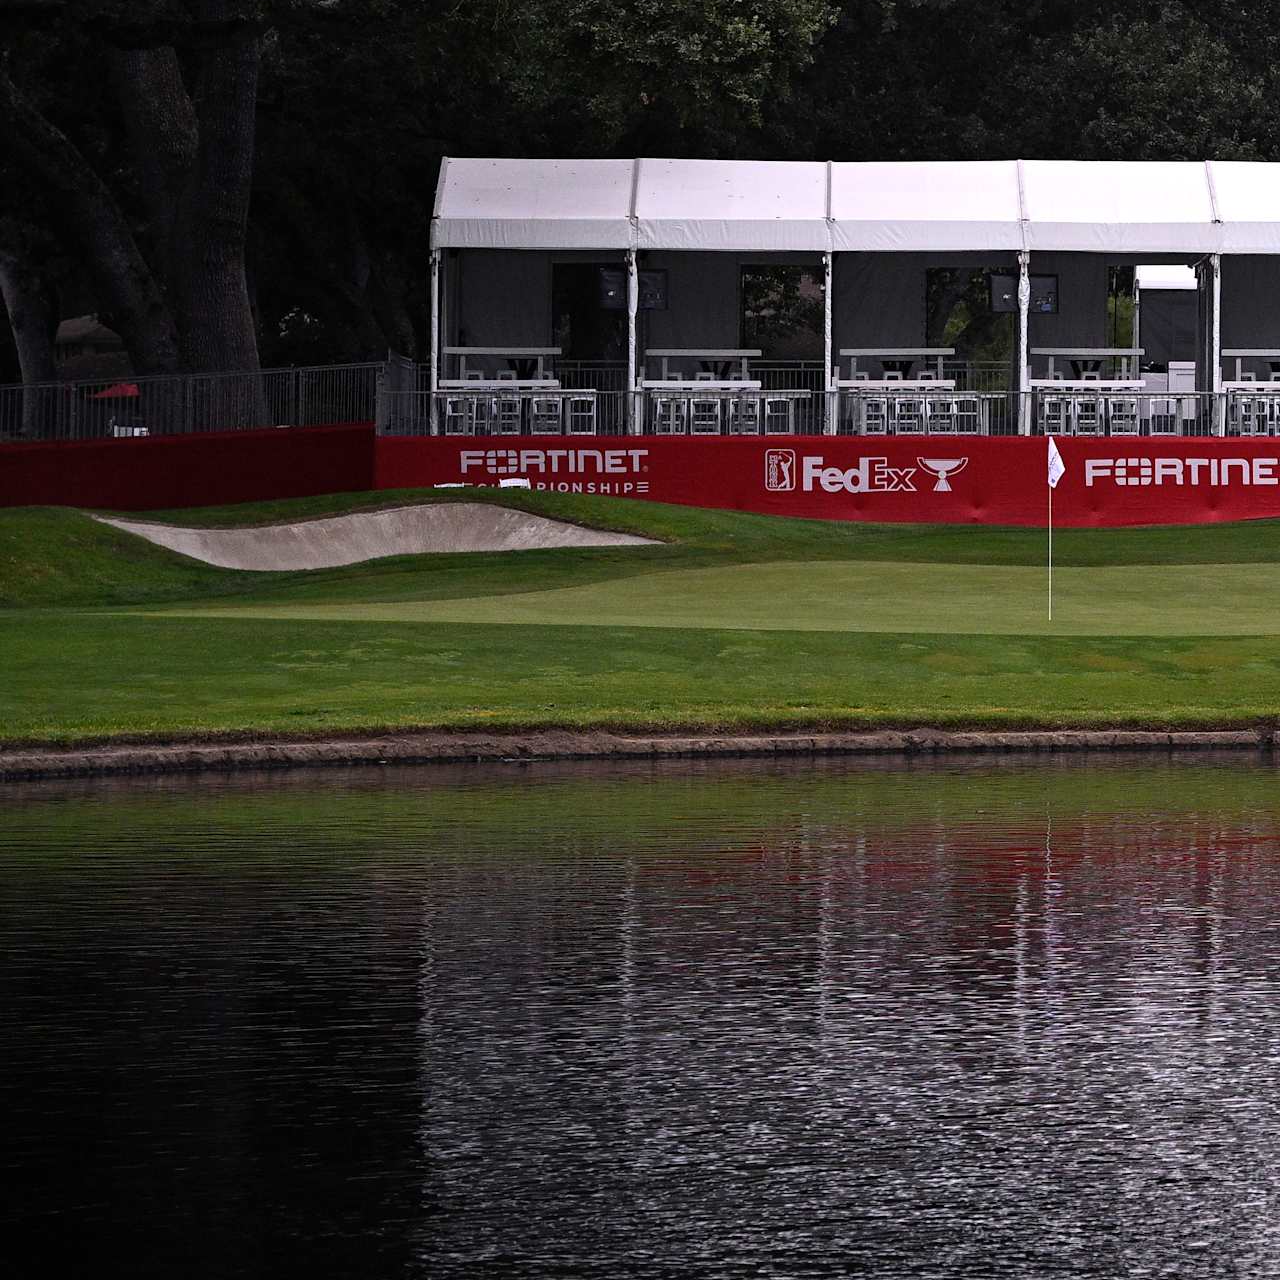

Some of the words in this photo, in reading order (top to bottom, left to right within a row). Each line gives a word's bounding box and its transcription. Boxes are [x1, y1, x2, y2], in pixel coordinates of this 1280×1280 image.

[460, 449, 649, 473] FORTINET
[802, 456, 917, 493] FedEx
[477, 482, 634, 493] PIONSHIP
